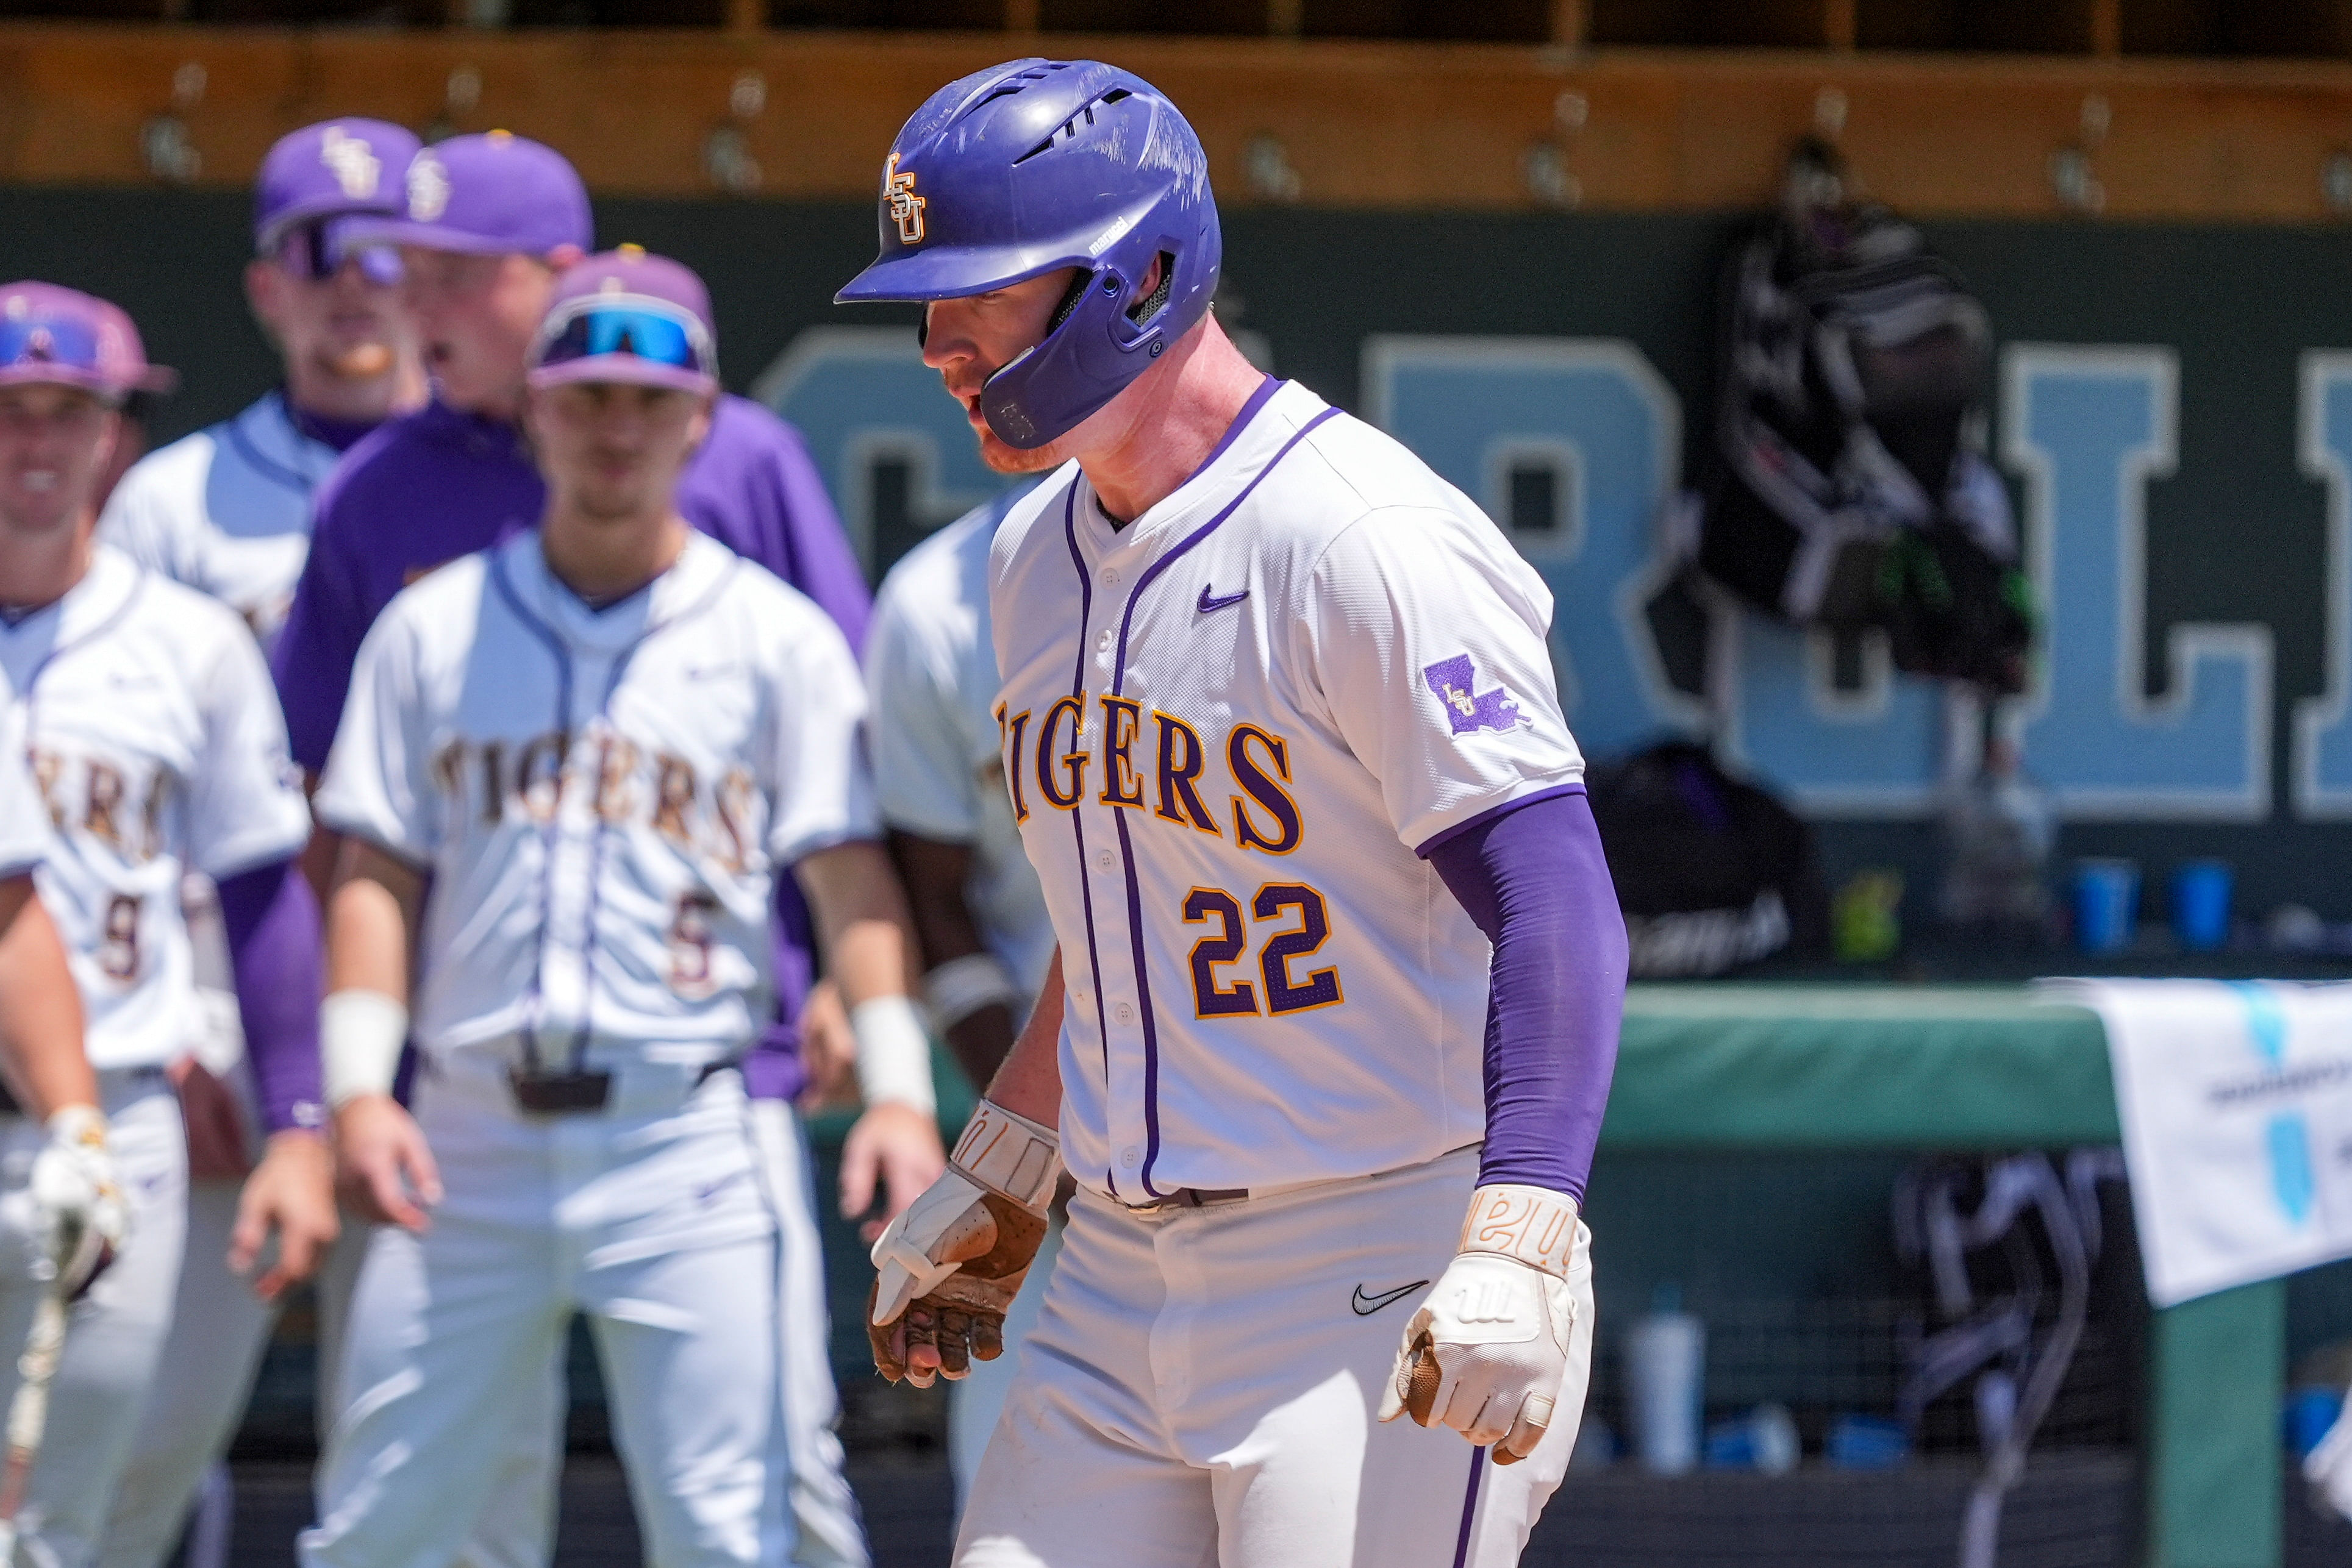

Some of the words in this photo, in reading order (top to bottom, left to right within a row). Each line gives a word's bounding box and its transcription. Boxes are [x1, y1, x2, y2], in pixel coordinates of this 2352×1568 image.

[883, 152, 926, 245] LSU
[1088, 216, 1128, 255] marucci
[1442, 682, 1476, 717] LSU
[996, 690, 1304, 856] IGERS
[101, 887, 144, 982] 9
[1181, 882, 1345, 1021] 22
